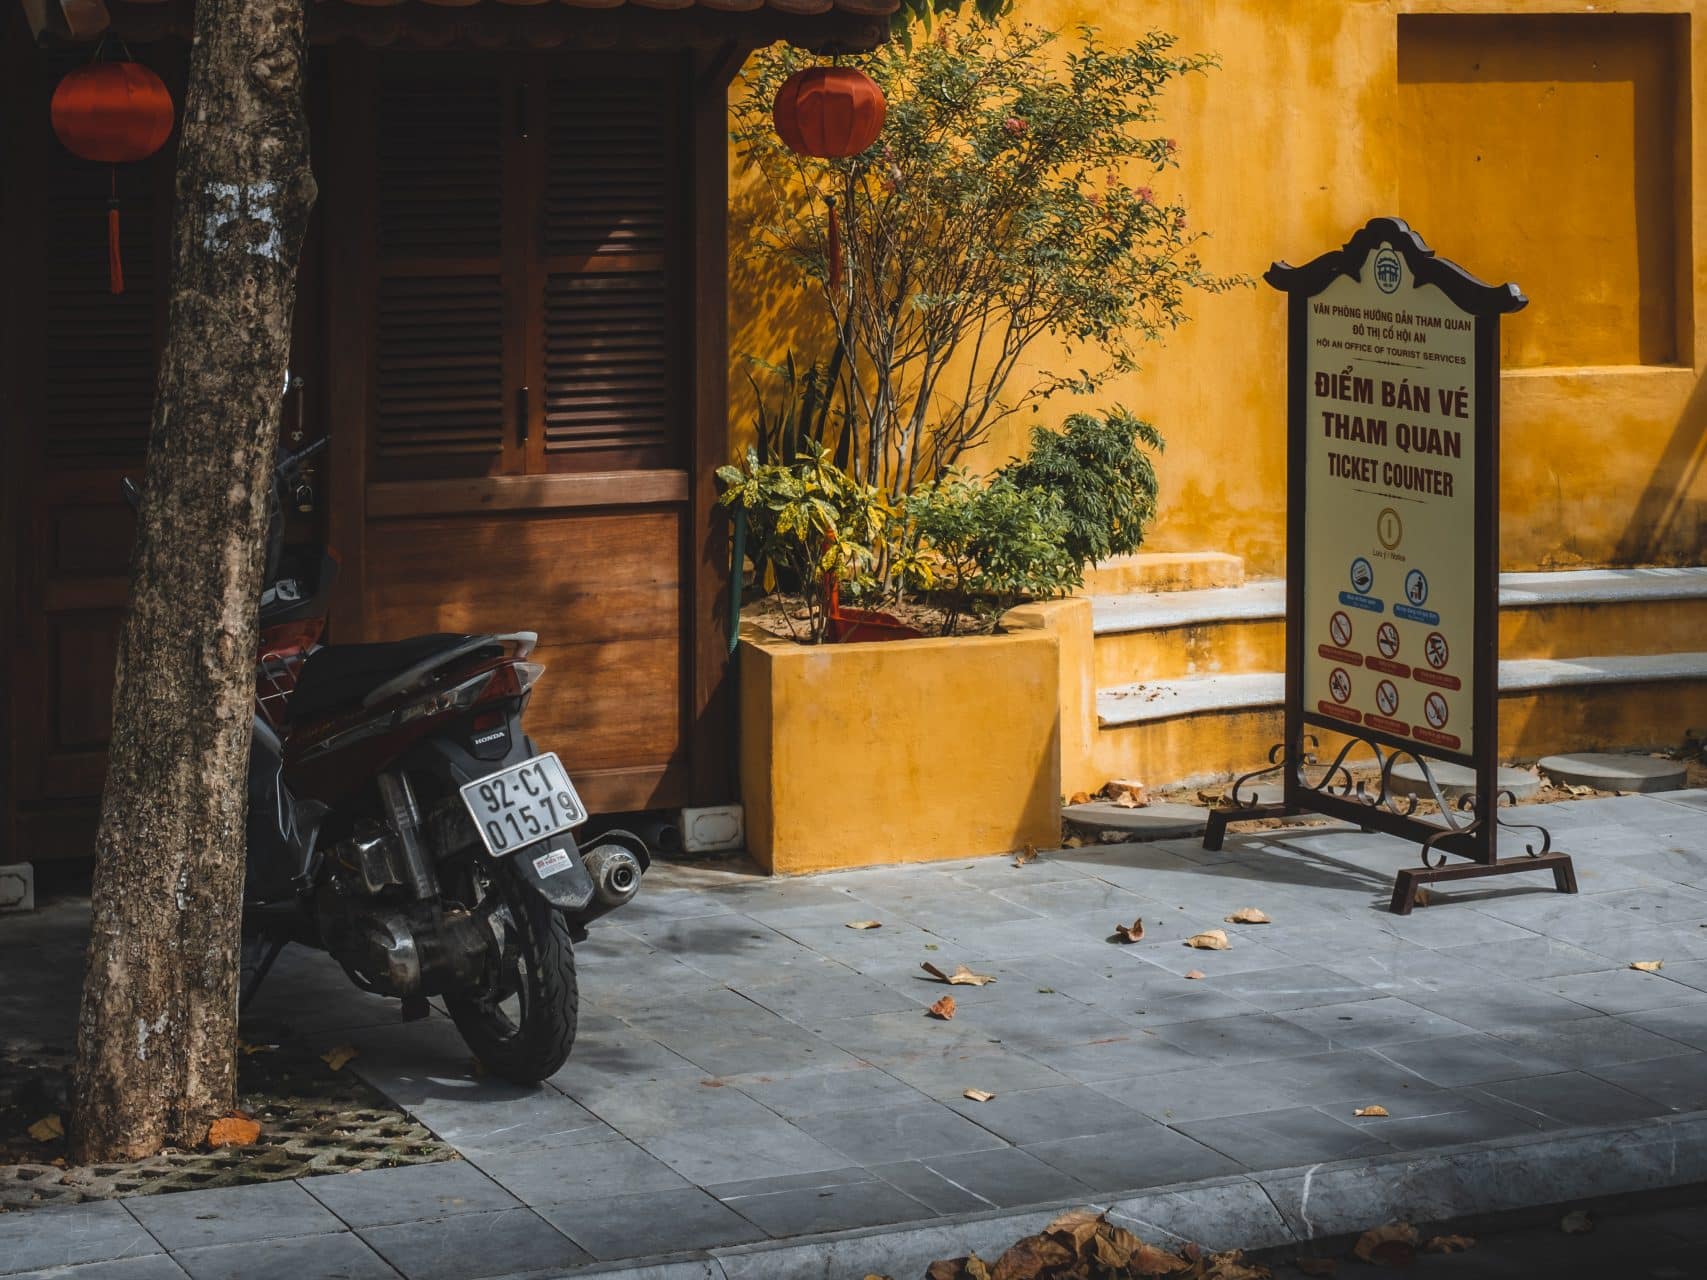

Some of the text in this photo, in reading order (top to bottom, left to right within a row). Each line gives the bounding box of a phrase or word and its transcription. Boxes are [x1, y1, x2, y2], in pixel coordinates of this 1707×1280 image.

[1367, 326, 1381, 340] THỊ
[1396, 329, 1411, 344] HỘI
[1413, 332, 1426, 344] AN
[1415, 315, 1442, 328] THAM
[1444, 318, 1471, 331] QUAN
[1316, 338, 1466, 365] HỘI AN OFFICE OF TOURIST SERVICES
[1314, 365, 1469, 419] ĐIỂM BÁN VÉ
[1322, 411, 1461, 459] THAM QUAN
[1328, 452, 1454, 497] TICKET COUNTER
[475, 731, 505, 745] HONDA
[480, 763, 555, 813] 92-C1
[486, 791, 579, 850] 015.79
